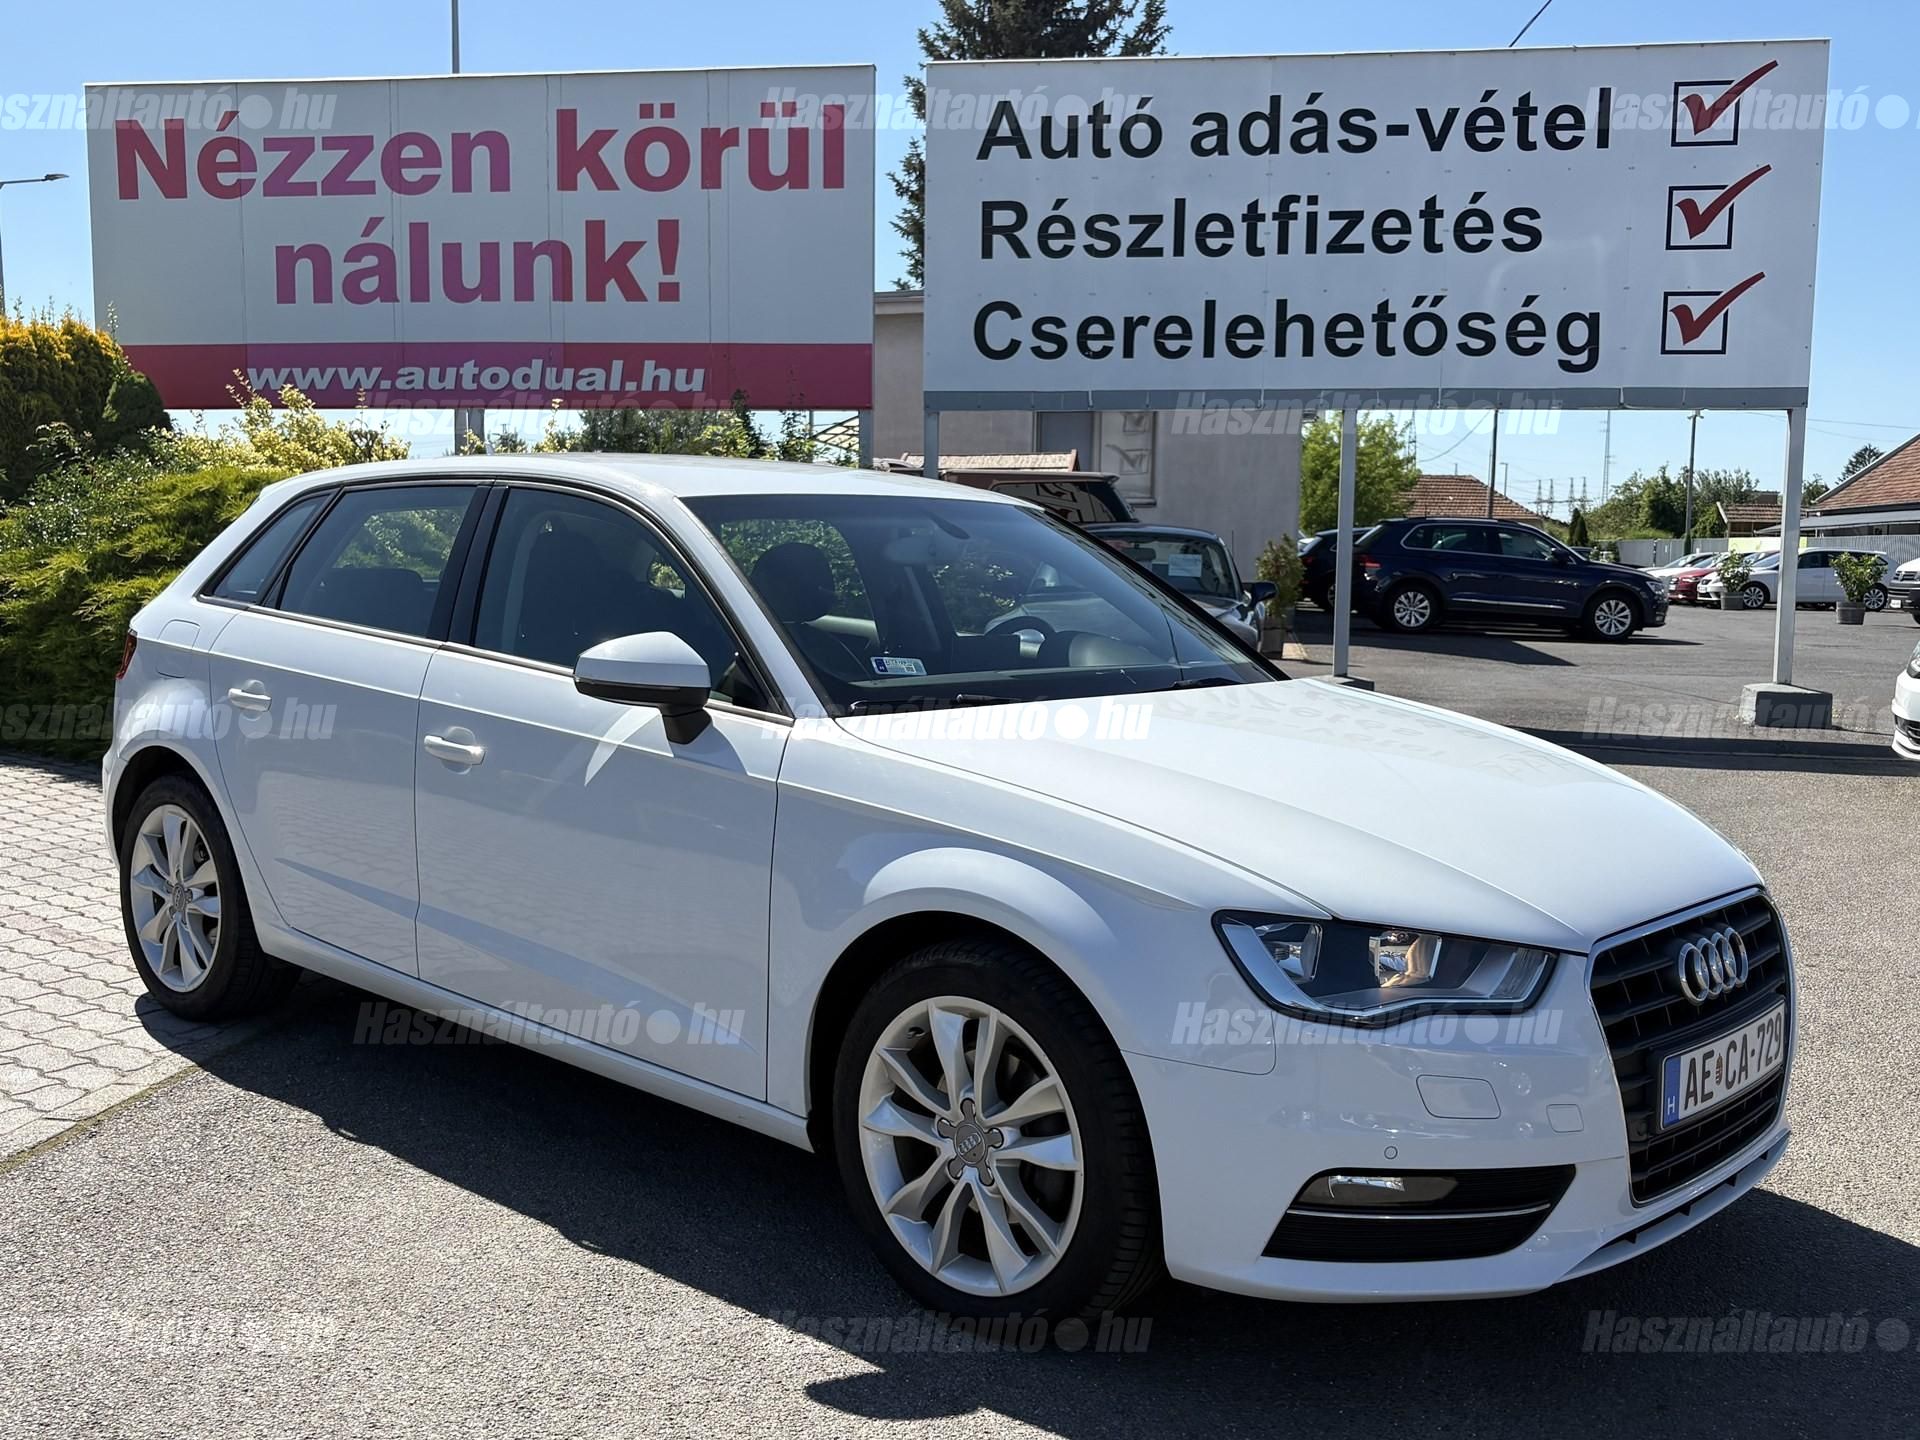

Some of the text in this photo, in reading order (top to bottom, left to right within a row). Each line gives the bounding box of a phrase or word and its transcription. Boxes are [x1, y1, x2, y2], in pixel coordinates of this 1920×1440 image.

[118, 103, 845, 201] Nézzen körül
[976, 87, 1612, 161] Autó adás-vétel
[275, 217, 680, 306] nálunk!
[981, 191, 1543, 260] Részletfizetés
[973, 294, 1601, 374] Cserelehetőség
[248, 358, 706, 393] www.autodual.hu
[1684, 1011, 1782, 1111] AE CA-729
[1667, 1095, 1676, 1116] H
